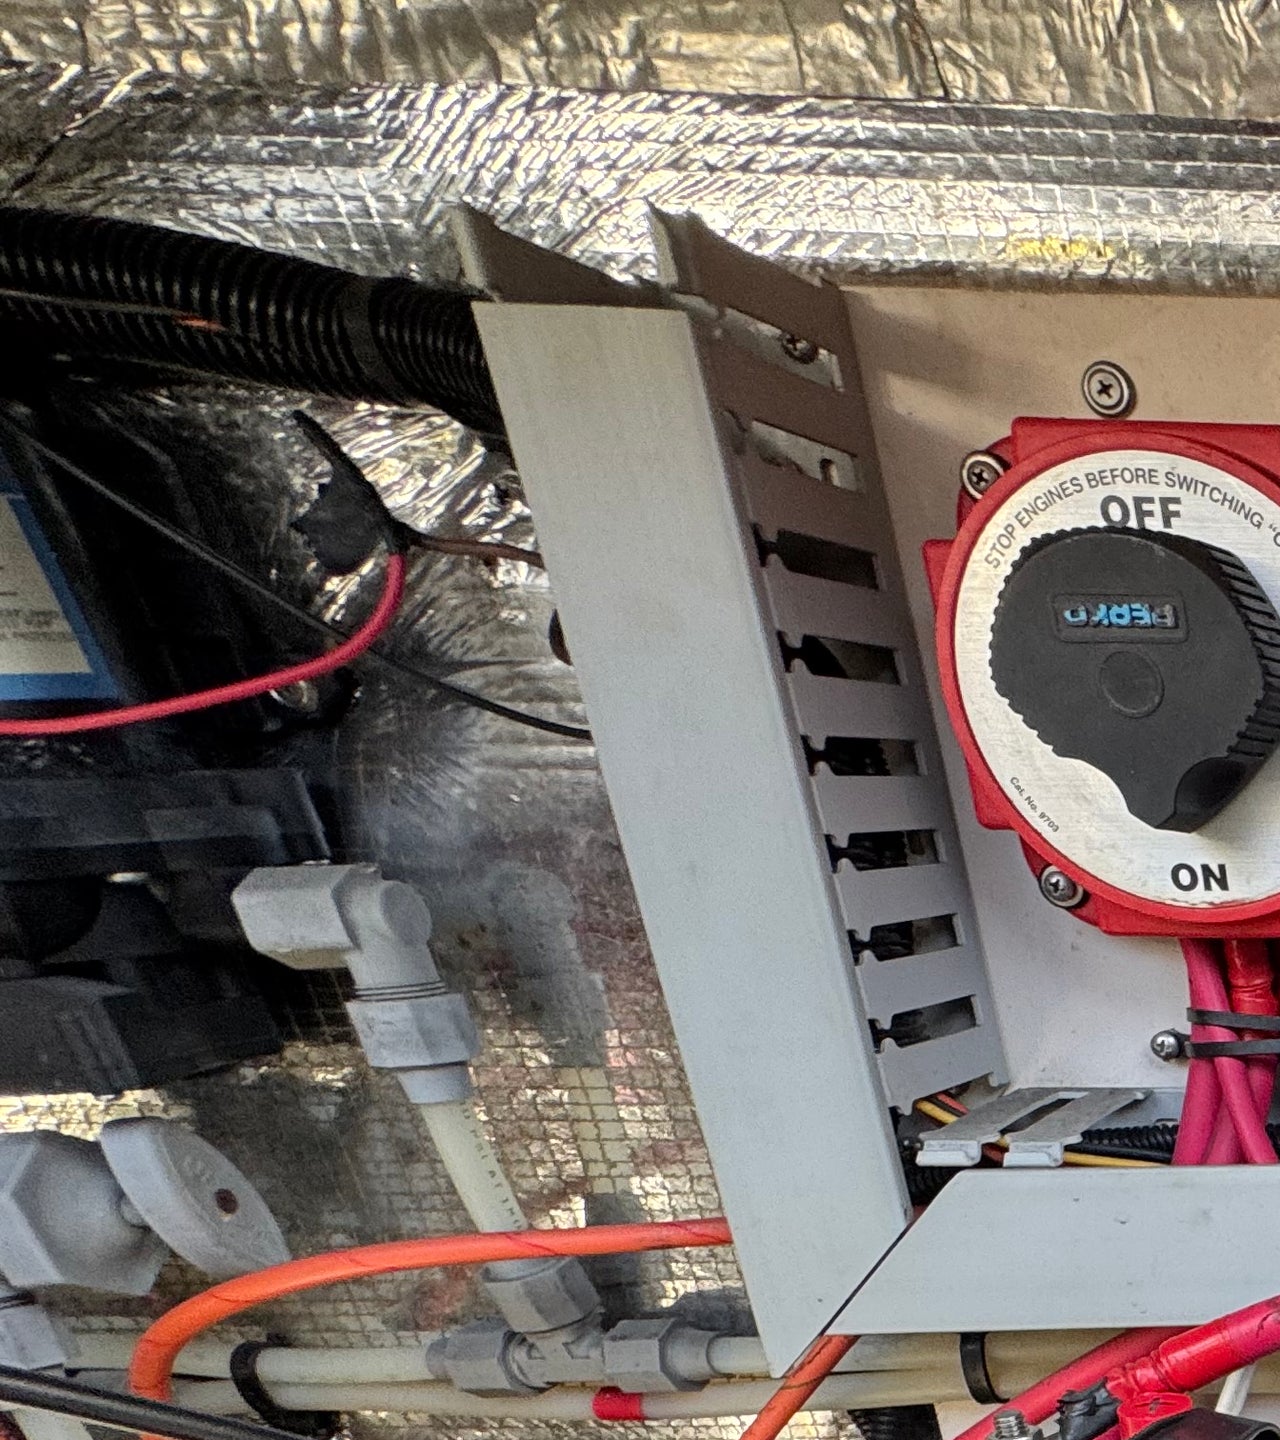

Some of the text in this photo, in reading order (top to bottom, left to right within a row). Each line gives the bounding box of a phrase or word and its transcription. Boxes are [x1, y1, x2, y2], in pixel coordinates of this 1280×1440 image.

[984, 523, 1017, 569] STOP
[1015, 477, 1084, 529] ENGINES
[1085, 467, 1160, 489] BEFORE
[1164, 471, 1265, 530] SWITCHING
[1100, 494, 1183, 530] OFF
[1171, 862, 1230, 893] ON
